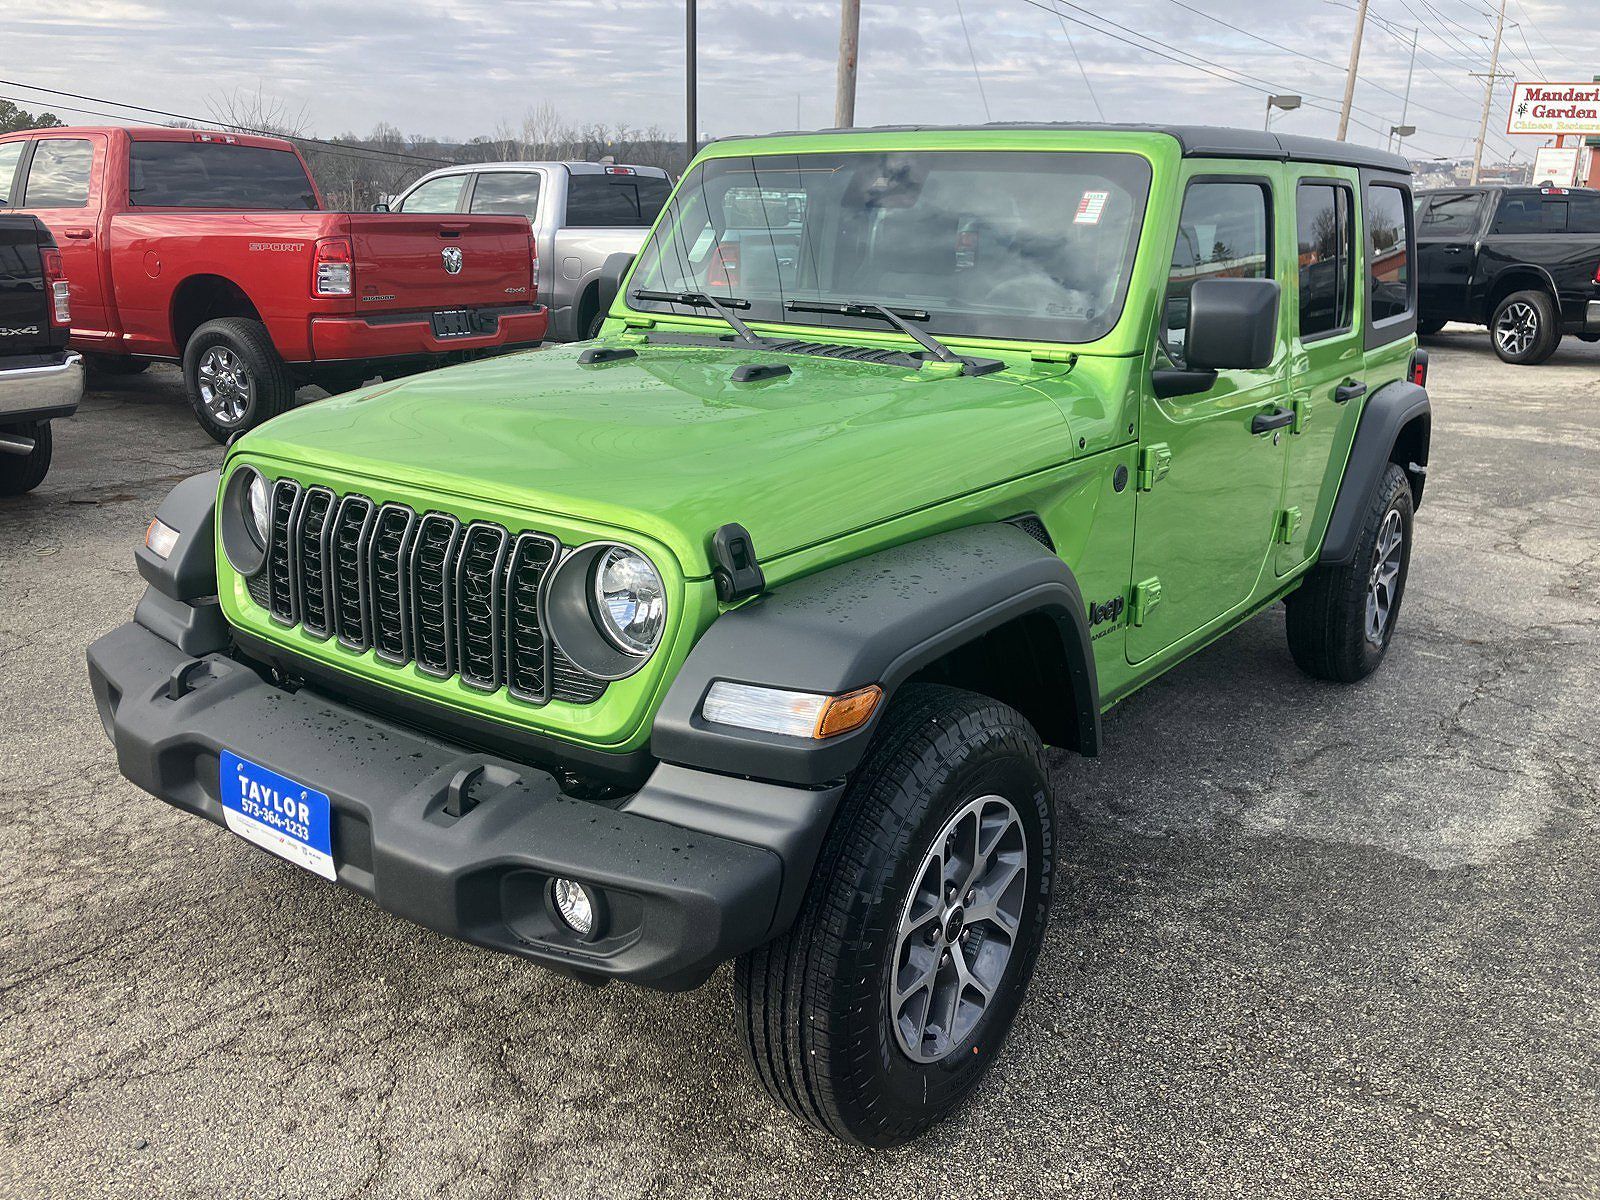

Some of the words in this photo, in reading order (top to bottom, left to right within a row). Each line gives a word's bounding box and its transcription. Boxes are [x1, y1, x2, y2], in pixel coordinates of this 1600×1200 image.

[1524, 88, 1600, 102] Mandari
[1532, 105, 1598, 118] Garden
[1556, 121, 1600, 131] Restaura
[249, 242, 305, 252] SPORT
[1088, 595, 1125, 628] Jeep
[238, 775, 310, 826] TAYLOR
[241, 798, 309, 841] 573-364-1233
[1033, 790, 1052, 895] ROADIAN
